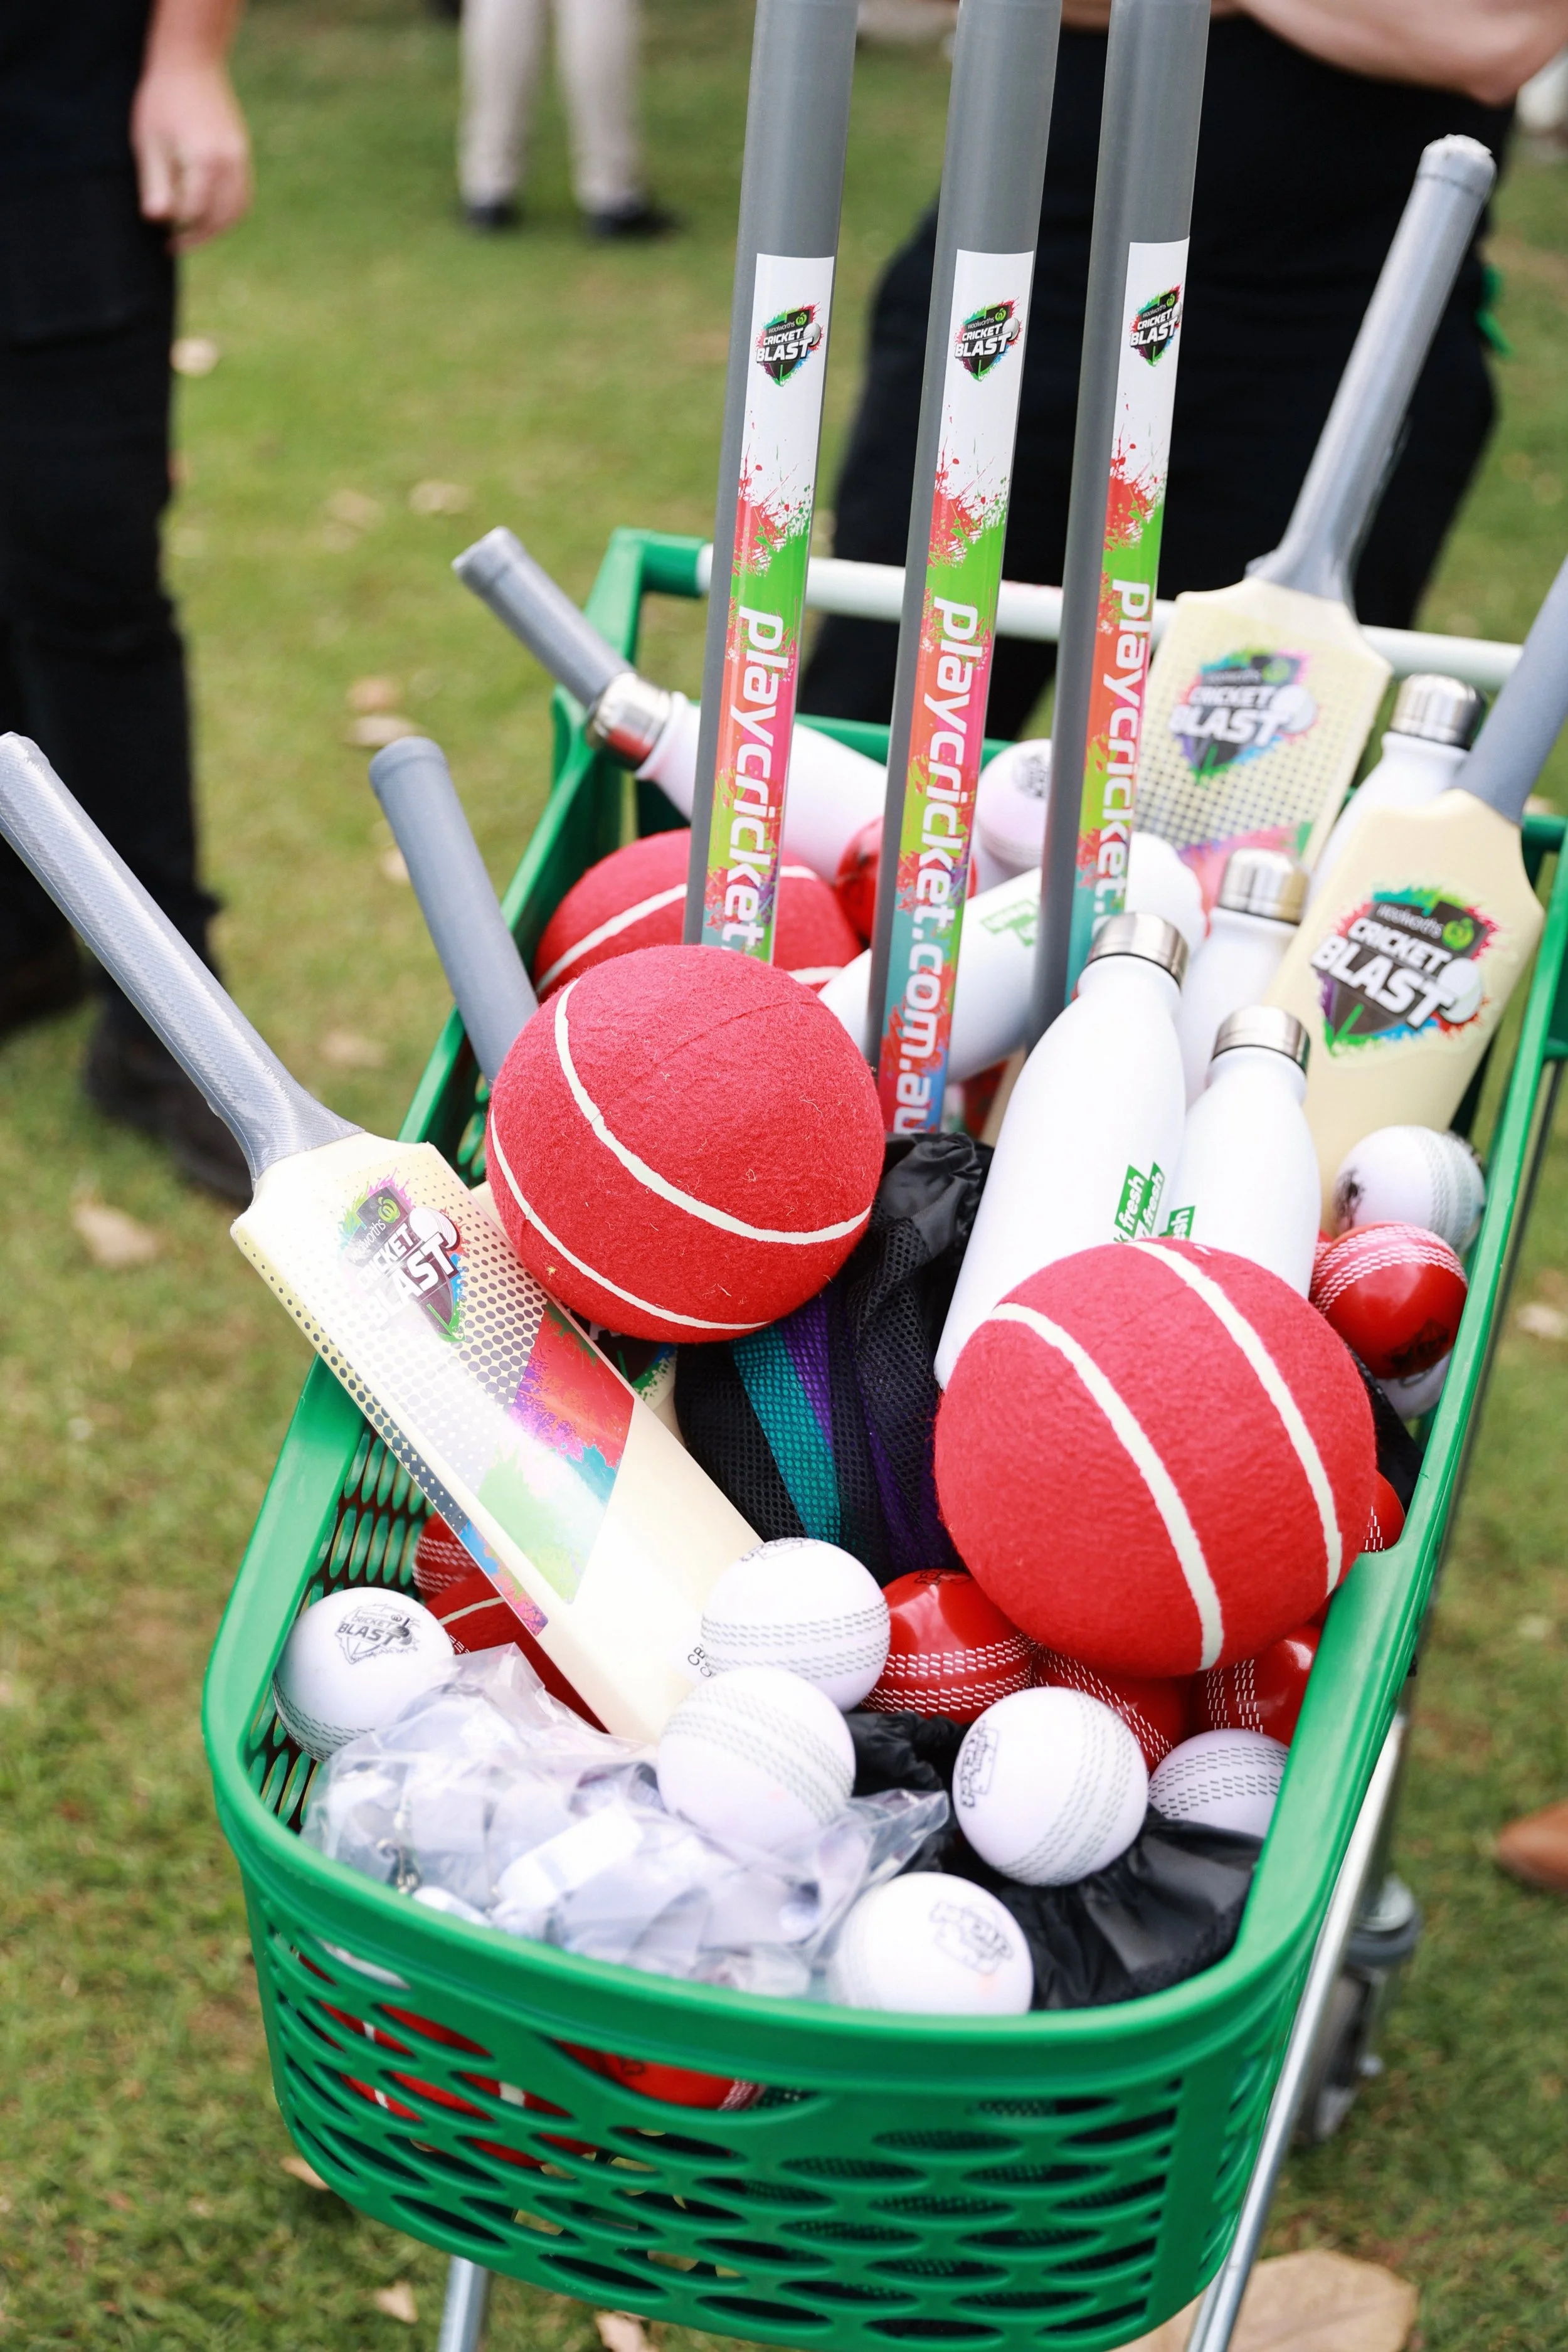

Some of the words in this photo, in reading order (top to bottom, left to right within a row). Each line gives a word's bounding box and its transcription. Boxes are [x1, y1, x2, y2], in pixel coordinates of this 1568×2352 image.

[768, 320, 795, 334] woolworths
[1130, 316, 1178, 346] BLAST
[1137, 308, 1172, 331] CRICKET
[763, 327, 803, 346] CRICKET
[955, 332, 1012, 357] BLAST
[961, 323, 1003, 342] CRICKET
[756, 337, 813, 363] BLAST
[1189, 686, 1277, 709] CRICKET
[1168, 704, 1290, 747] BLAST
[893, 596, 983, 1134] playcricket.com.au
[1348, 916, 1453, 972] CRICKET
[1311, 934, 1455, 1028] BLAST
[1118, 1175, 1145, 1231] fresh
[337, 1623, 401, 1645] BLAST
